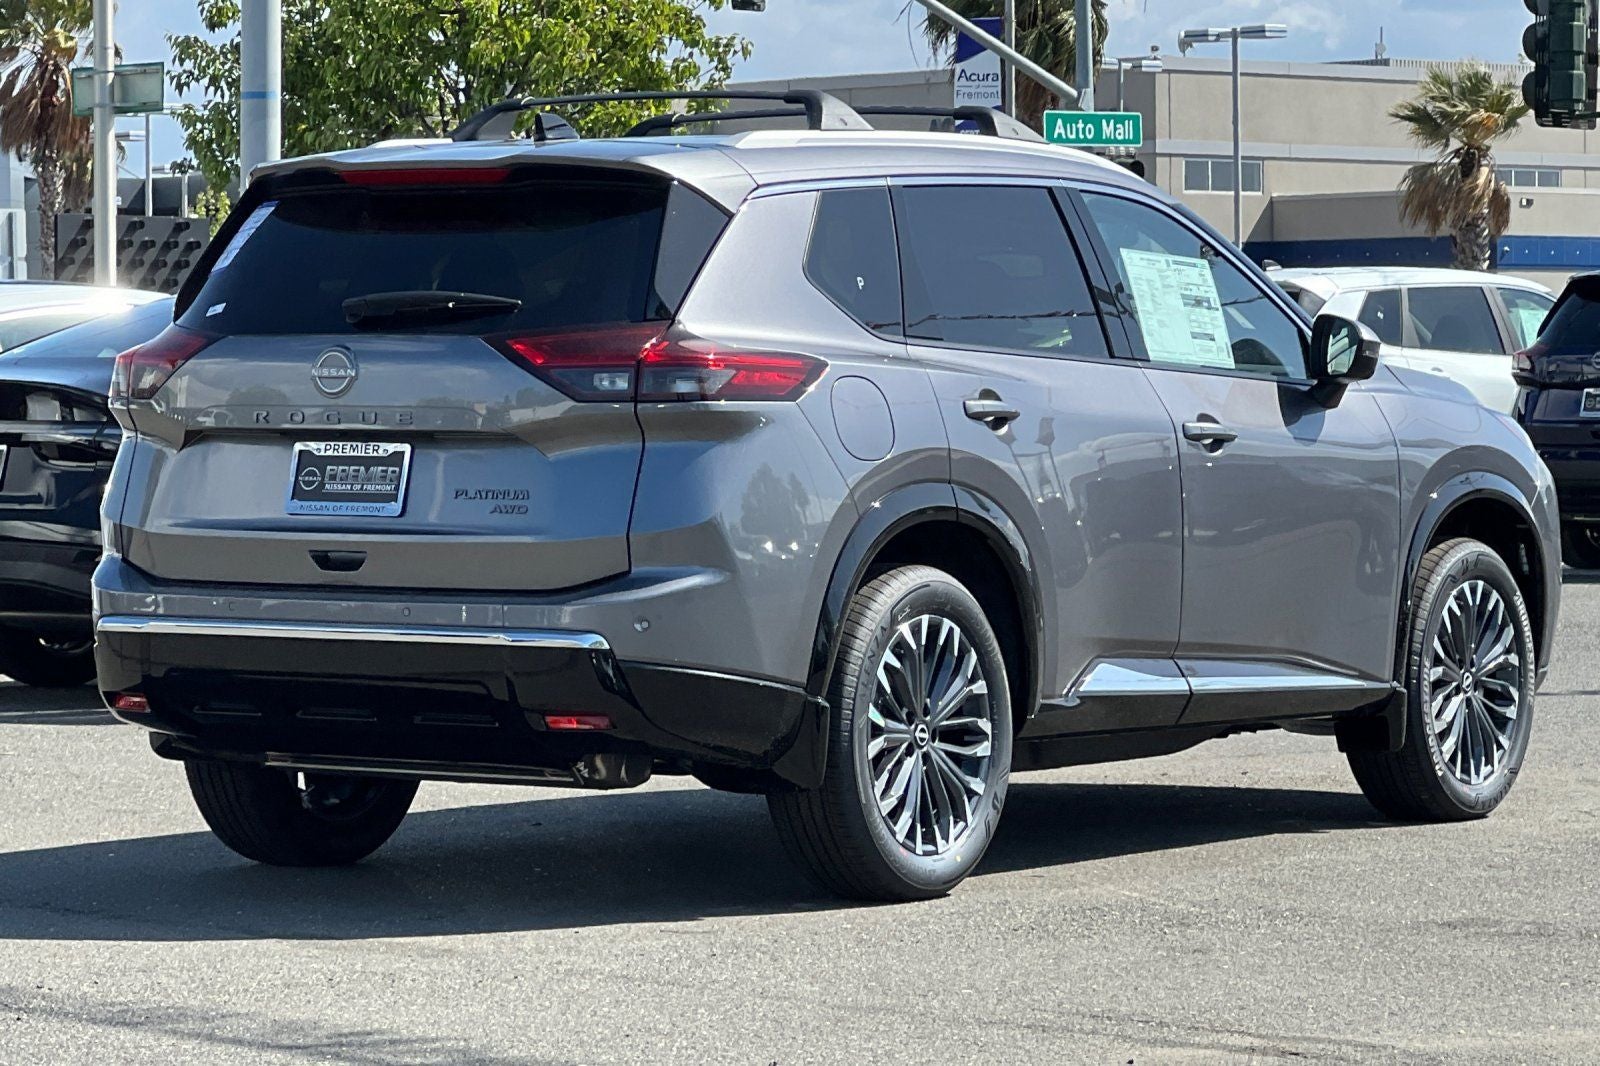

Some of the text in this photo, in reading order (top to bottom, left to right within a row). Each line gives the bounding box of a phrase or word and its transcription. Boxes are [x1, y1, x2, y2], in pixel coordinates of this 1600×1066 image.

[957, 68, 999, 82] Acura
[956, 89, 999, 99] Fremont
[1053, 118, 1133, 140] Auto Mall
[311, 368, 356, 377] NISSAN
[253, 410, 414, 425] ROGUE
[324, 443, 380, 455] PREMIER
[324, 465, 400, 484] PREMIER
[324, 483, 351, 491] NISSAN
[363, 484, 395, 492] FREMONT
[454, 488, 530, 501] PLATINUM
[299, 504, 386, 514] NISSAN OF FREMONT
[488, 503, 529, 515] AWD
